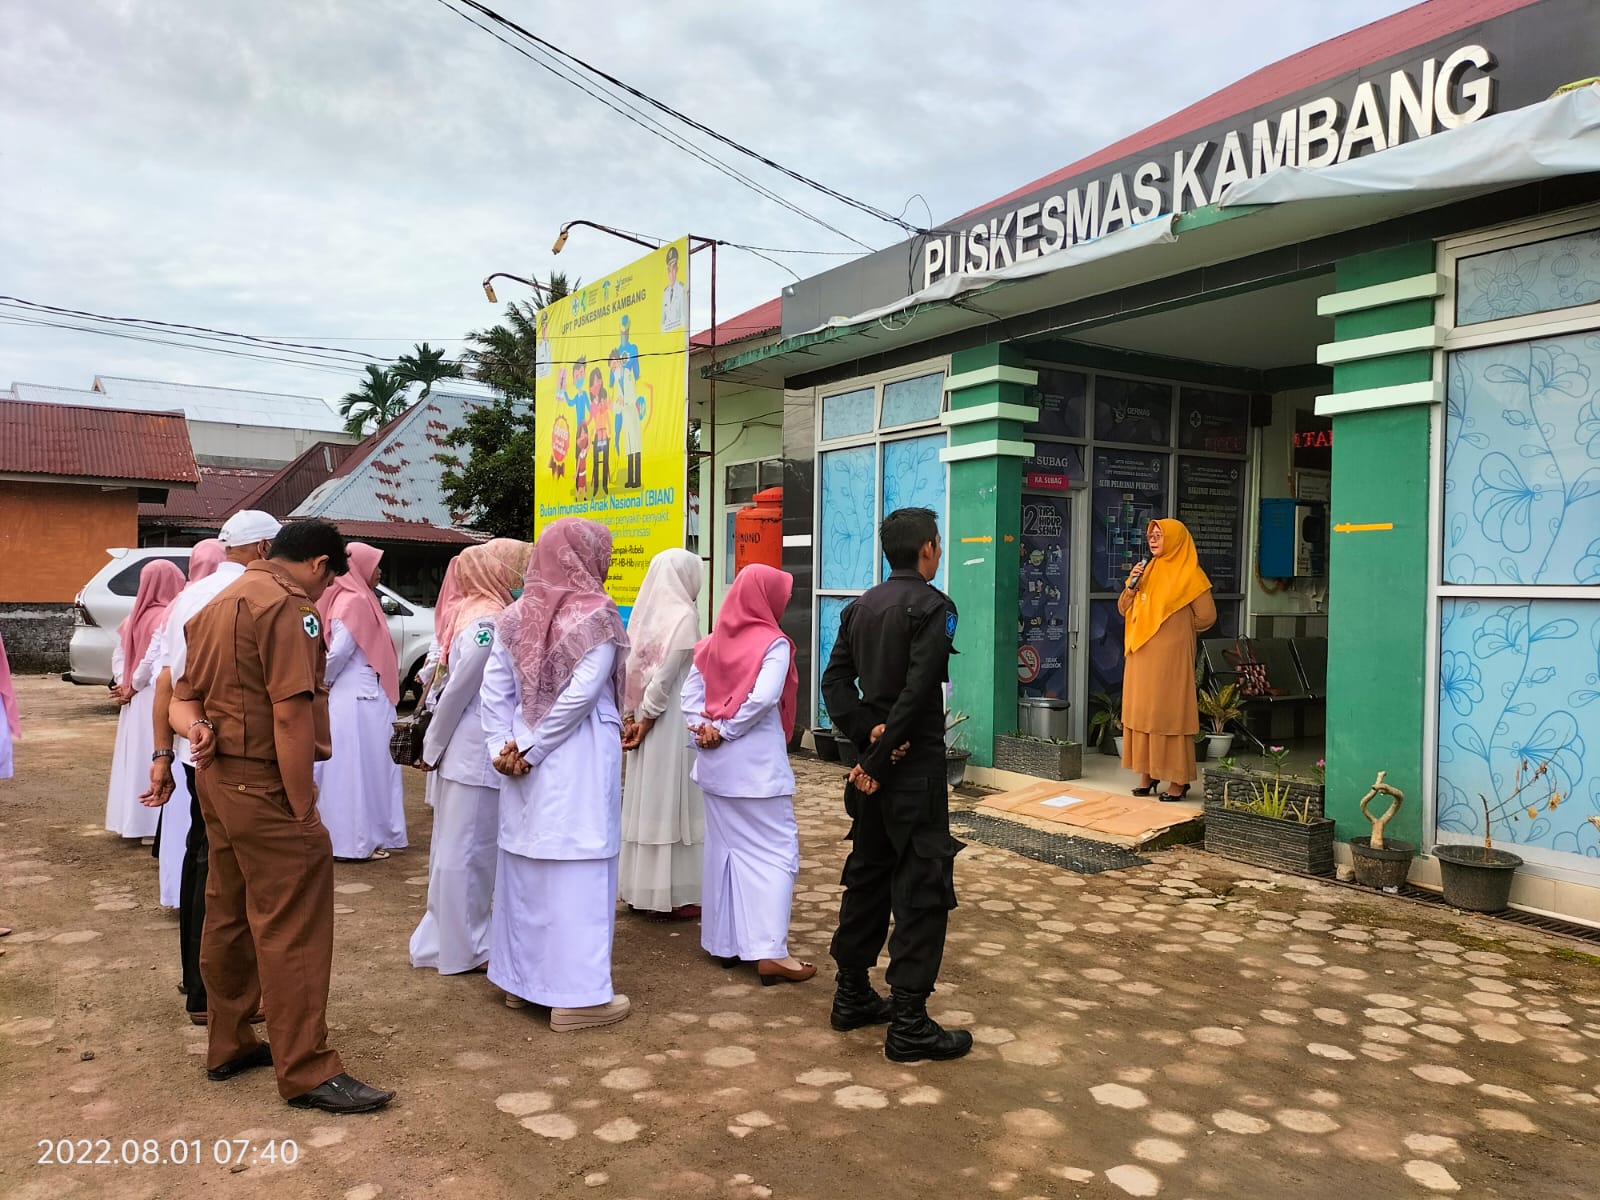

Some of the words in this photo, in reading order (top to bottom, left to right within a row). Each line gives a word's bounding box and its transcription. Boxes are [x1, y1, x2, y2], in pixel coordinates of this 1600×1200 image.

[924, 161, 1165, 287] PUSKESMAS
[1173, 44, 1498, 214] KAMBANG
[574, 304, 611, 330] PUSKESMAS
[611, 288, 646, 314] KAMBANG
[1036, 456, 1069, 468] SUBAG
[540, 503, 557, 517] Bulan
[558, 501, 589, 516] Imunisasi
[590, 495, 608, 512] Anak
[609, 489, 643, 509] Nasional
[1038, 505, 1056, 518] TIPS
